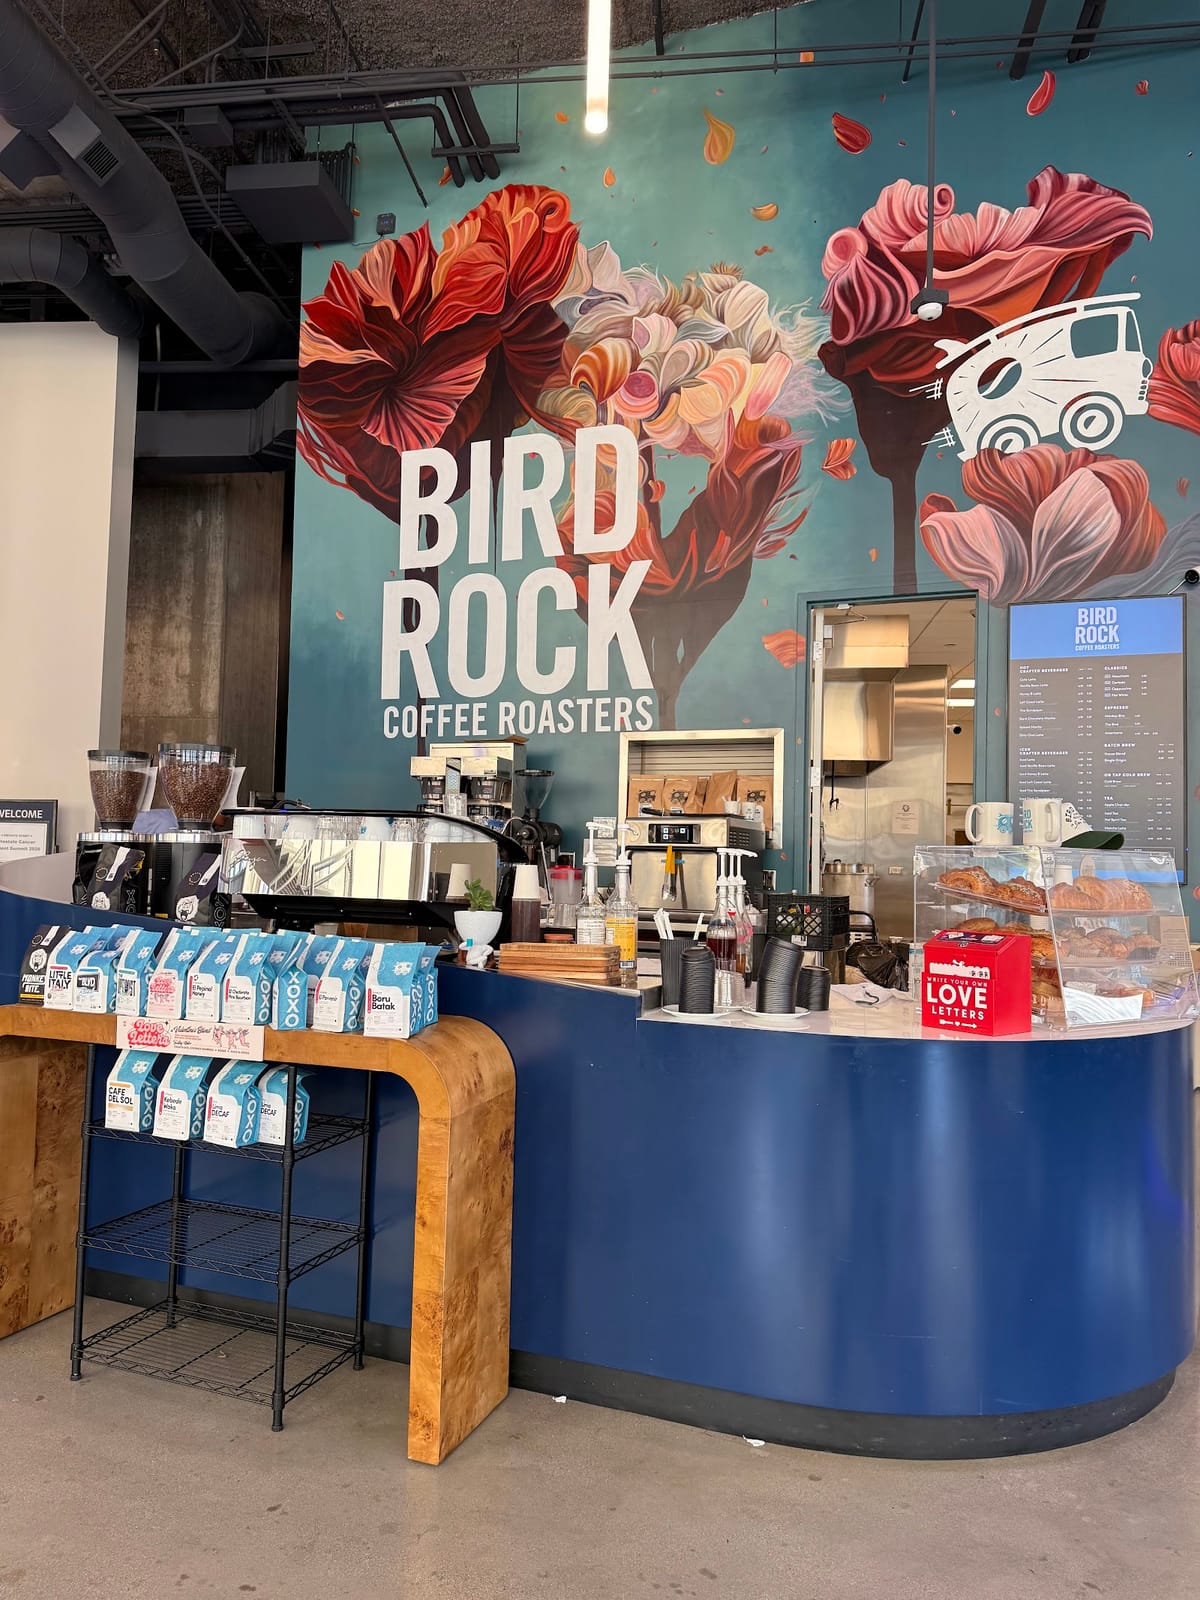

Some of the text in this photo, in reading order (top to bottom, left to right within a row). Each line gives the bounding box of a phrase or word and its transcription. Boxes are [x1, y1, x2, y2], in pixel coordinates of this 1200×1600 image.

[400, 424, 639, 570] BIRD
[1078, 607, 1117, 625] BIRD
[381, 560, 654, 699] ROCK
[1075, 625, 1119, 643] ROCK
[1075, 643, 1120, 652] COFFEE ROASTERS
[383, 695, 654, 738] COFFEE ROASTERS
[22, 973, 46, 983] MONKE
[49, 970, 72, 980] LITTLE
[48, 979, 71, 990] ITALY
[951, 978, 969, 986] YOUR
[285, 971, 301, 1027] XOXO
[372, 994, 391, 1002] Boru
[926, 982, 988, 1009] LOVE
[372, 1002, 395, 1010] Batak
[931, 1005, 985, 1020] LETTERS
[133, 1019, 165, 1035] Love
[128, 1031, 171, 1048] Letters
[109, 1086, 126, 1096] CAFE
[108, 1095, 134, 1105] DEL SOL
[211, 1109, 230, 1118] DECAF
